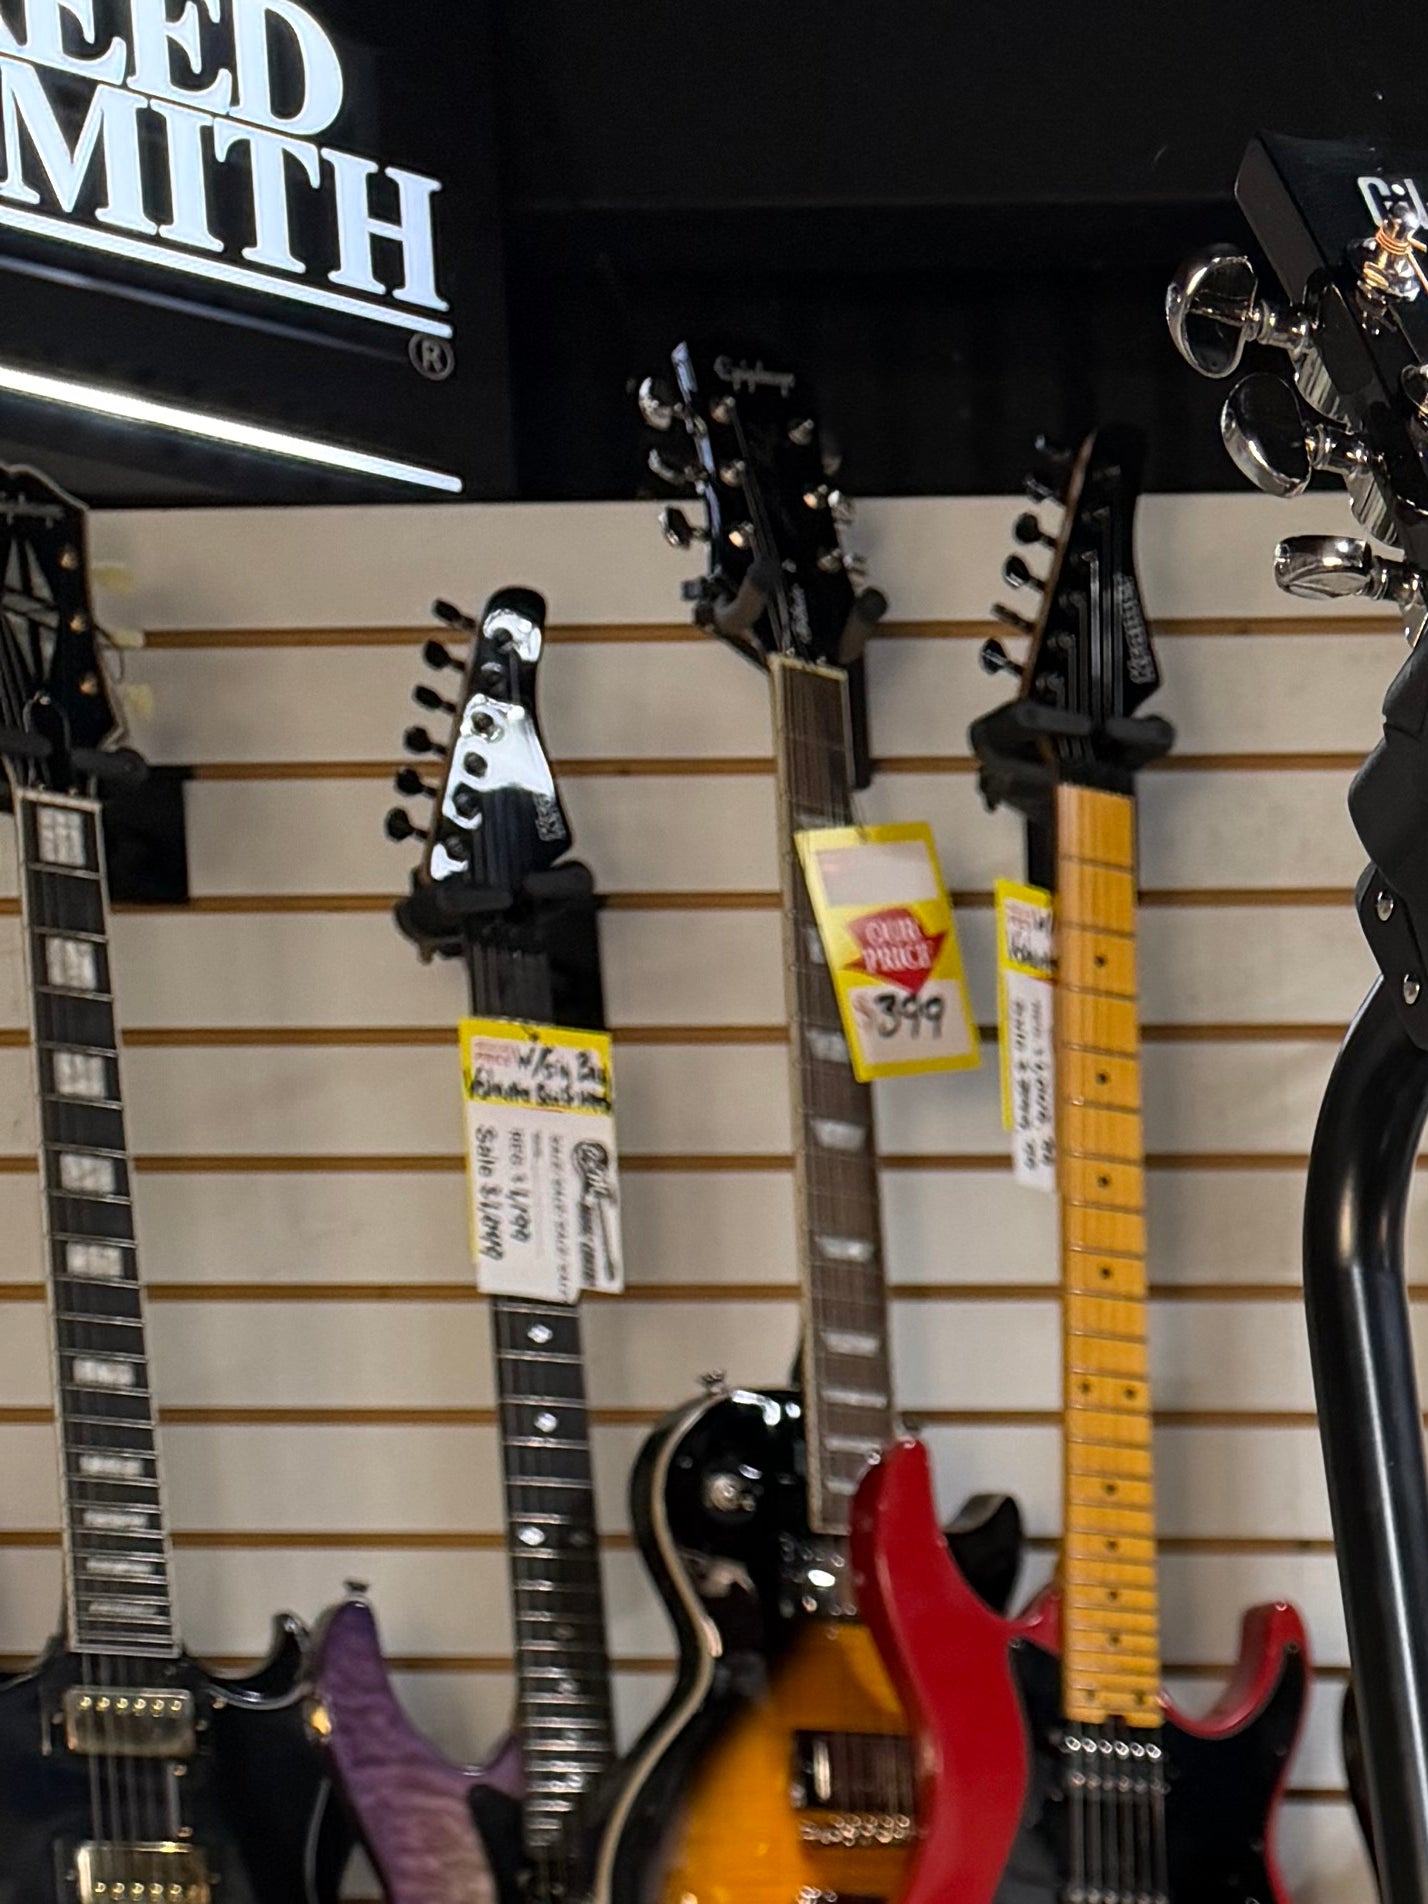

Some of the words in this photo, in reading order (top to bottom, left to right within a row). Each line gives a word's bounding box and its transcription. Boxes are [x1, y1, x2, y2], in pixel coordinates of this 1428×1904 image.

[0, 0, 344, 136] EED
[865, 915, 921, 946] OUR
[862, 939, 935, 975] PRICE
